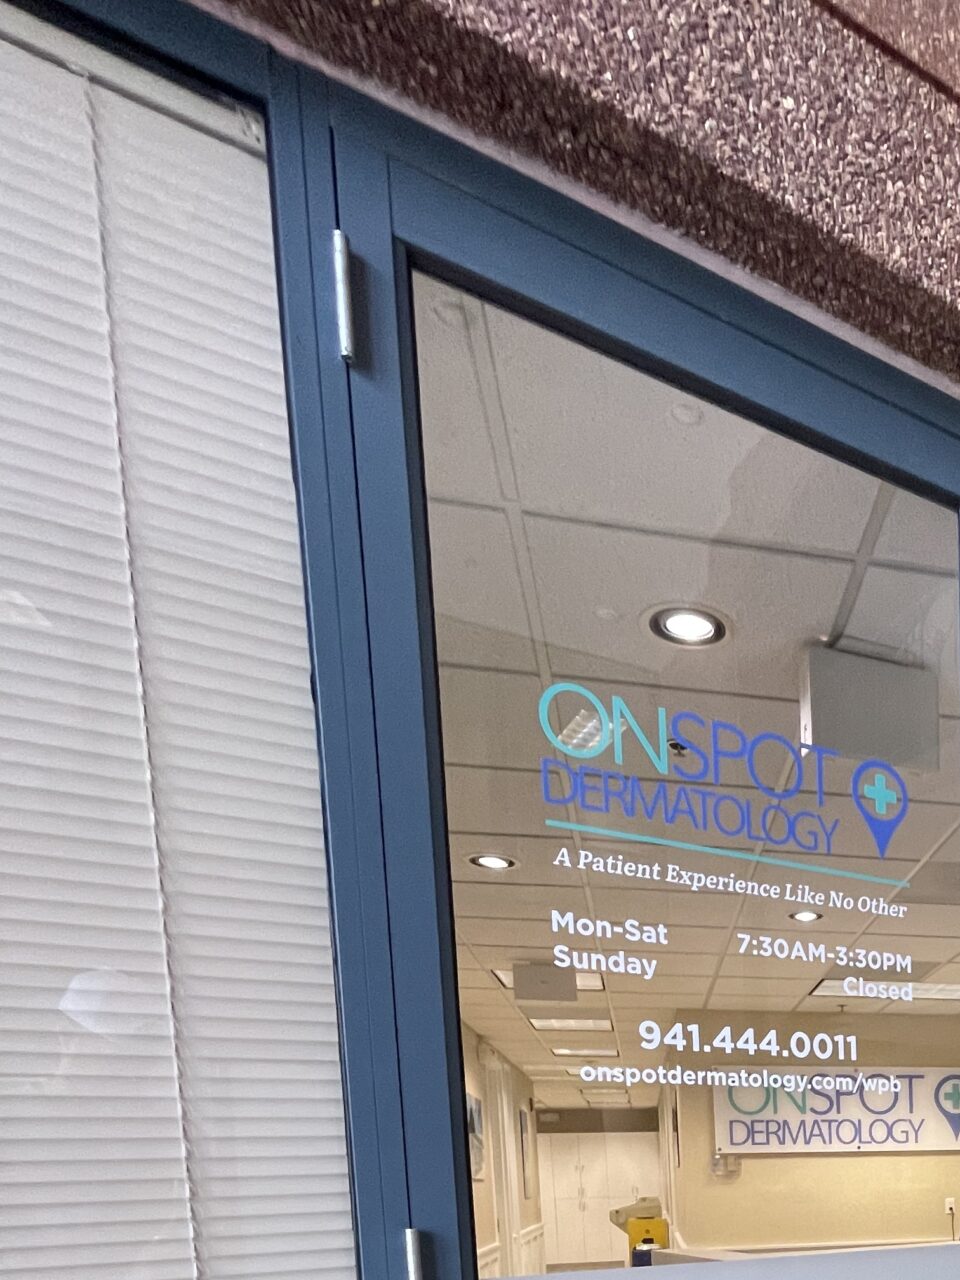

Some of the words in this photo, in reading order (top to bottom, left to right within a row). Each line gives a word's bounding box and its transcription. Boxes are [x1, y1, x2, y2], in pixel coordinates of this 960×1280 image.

[538, 682, 839, 808] ONSPOT
[540, 757, 840, 856] DERMATOLOGY
[553, 846, 572, 867] A
[577, 851, 662, 881] Patient
[665, 864, 780, 899] Experience
[784, 884, 825, 906] Like
[829, 891, 853, 911] No
[857, 896, 908, 918] Other
[551, 910, 668, 945] Mon-Sat
[736, 933, 913, 974] 7:30AM-3:30PM
[552, 944, 658, 979] Sunday
[843, 976, 913, 1002] Closed
[638, 1020, 858, 1061] 941.444.0011
[579, 1064, 902, 1094] onspotdermatology.com/wpb
[729, 1118, 926, 1146] DERMATOLOGY
